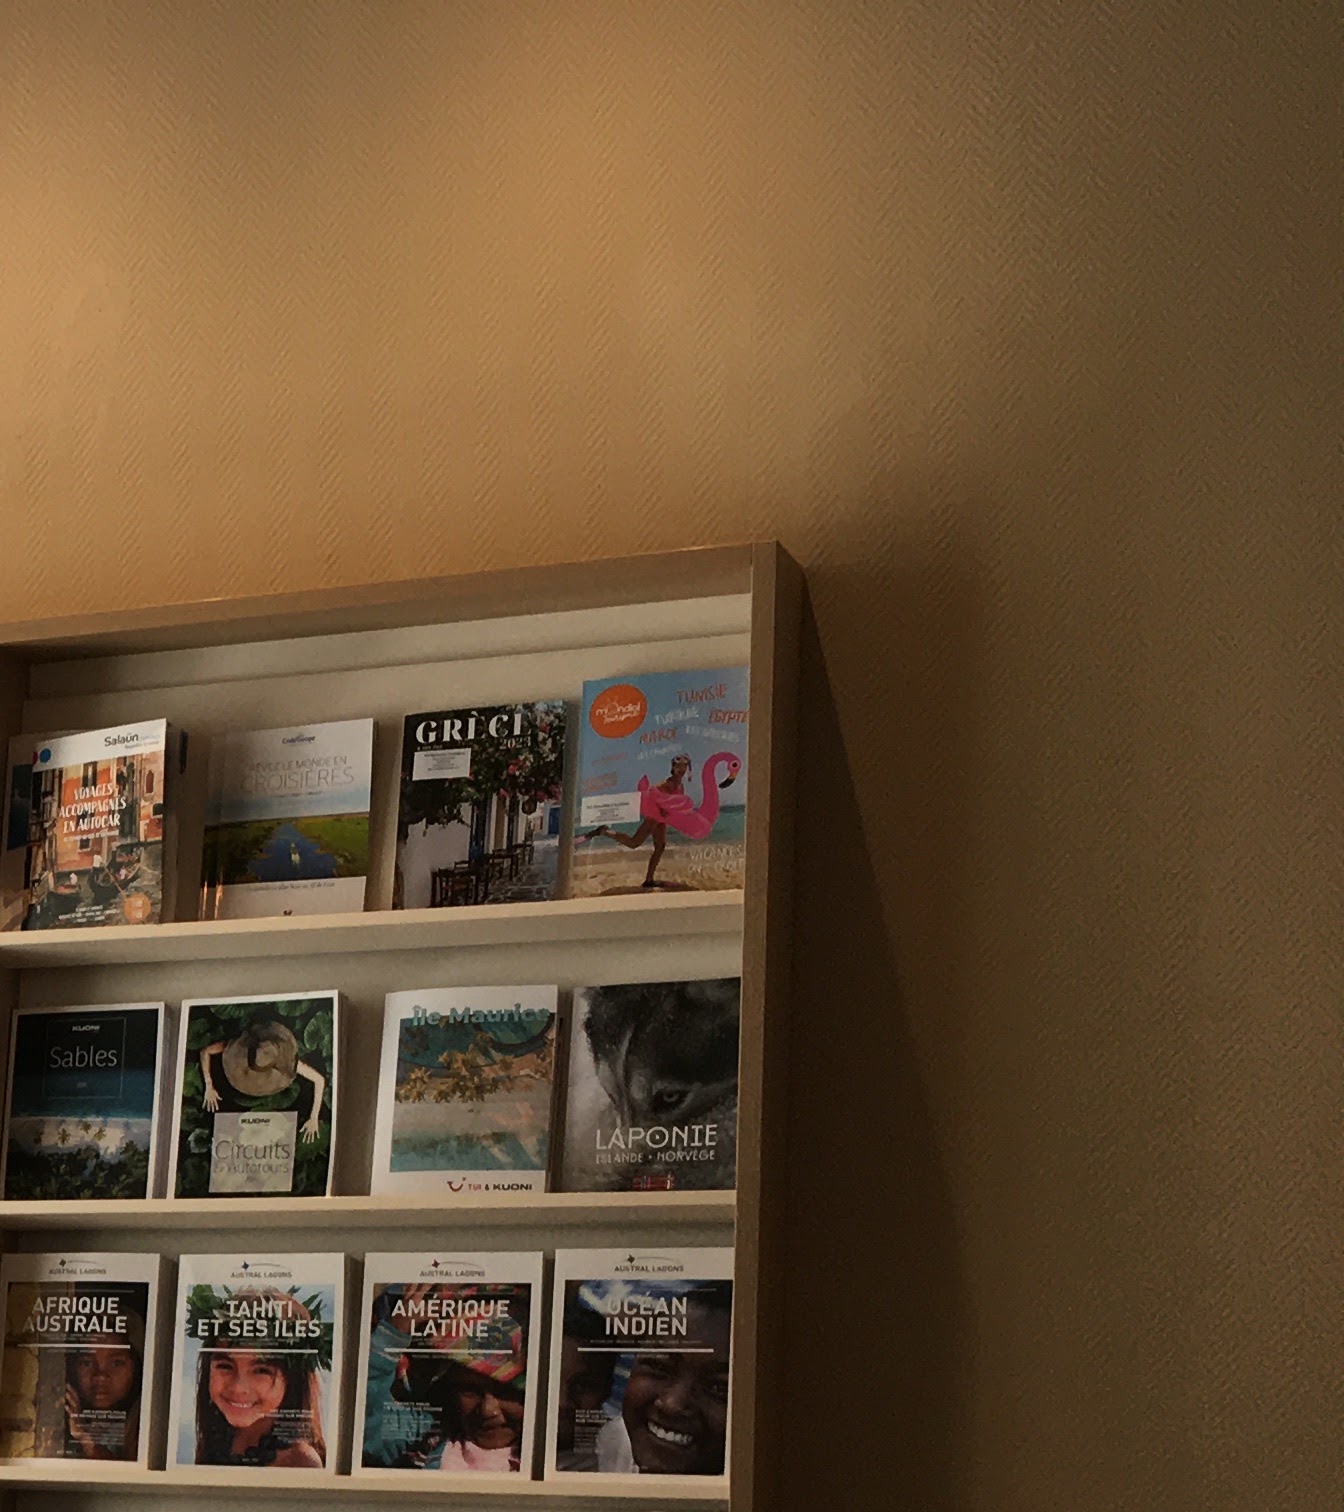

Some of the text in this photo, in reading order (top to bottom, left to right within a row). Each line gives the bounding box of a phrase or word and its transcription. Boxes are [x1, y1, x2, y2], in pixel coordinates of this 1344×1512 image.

[677, 683, 728, 704] TUNISIE
[104, 733, 139, 747] Salaün
[74, 783, 114, 800] VOYAGES
[63, 814, 120, 834] EN AUTOCAR
[448, 1003, 550, 1025] Maurice
[50, 1047, 118, 1068] Sables
[596, 1124, 718, 1150] LAPONIE
[215, 1140, 291, 1160] Circuits
[32, 1297, 120, 1314] AFRIQUE
[226, 1300, 293, 1318] TAHITI
[391, 1294, 510, 1318] AMÉRIQUE
[608, 1291, 688, 1315] OCÉAN
[22, 1316, 128, 1333] AUSTRALE
[197, 1319, 321, 1337] ET SES ILES
[411, 1319, 489, 1337] LATINE
[605, 1317, 688, 1336] INDIEN
